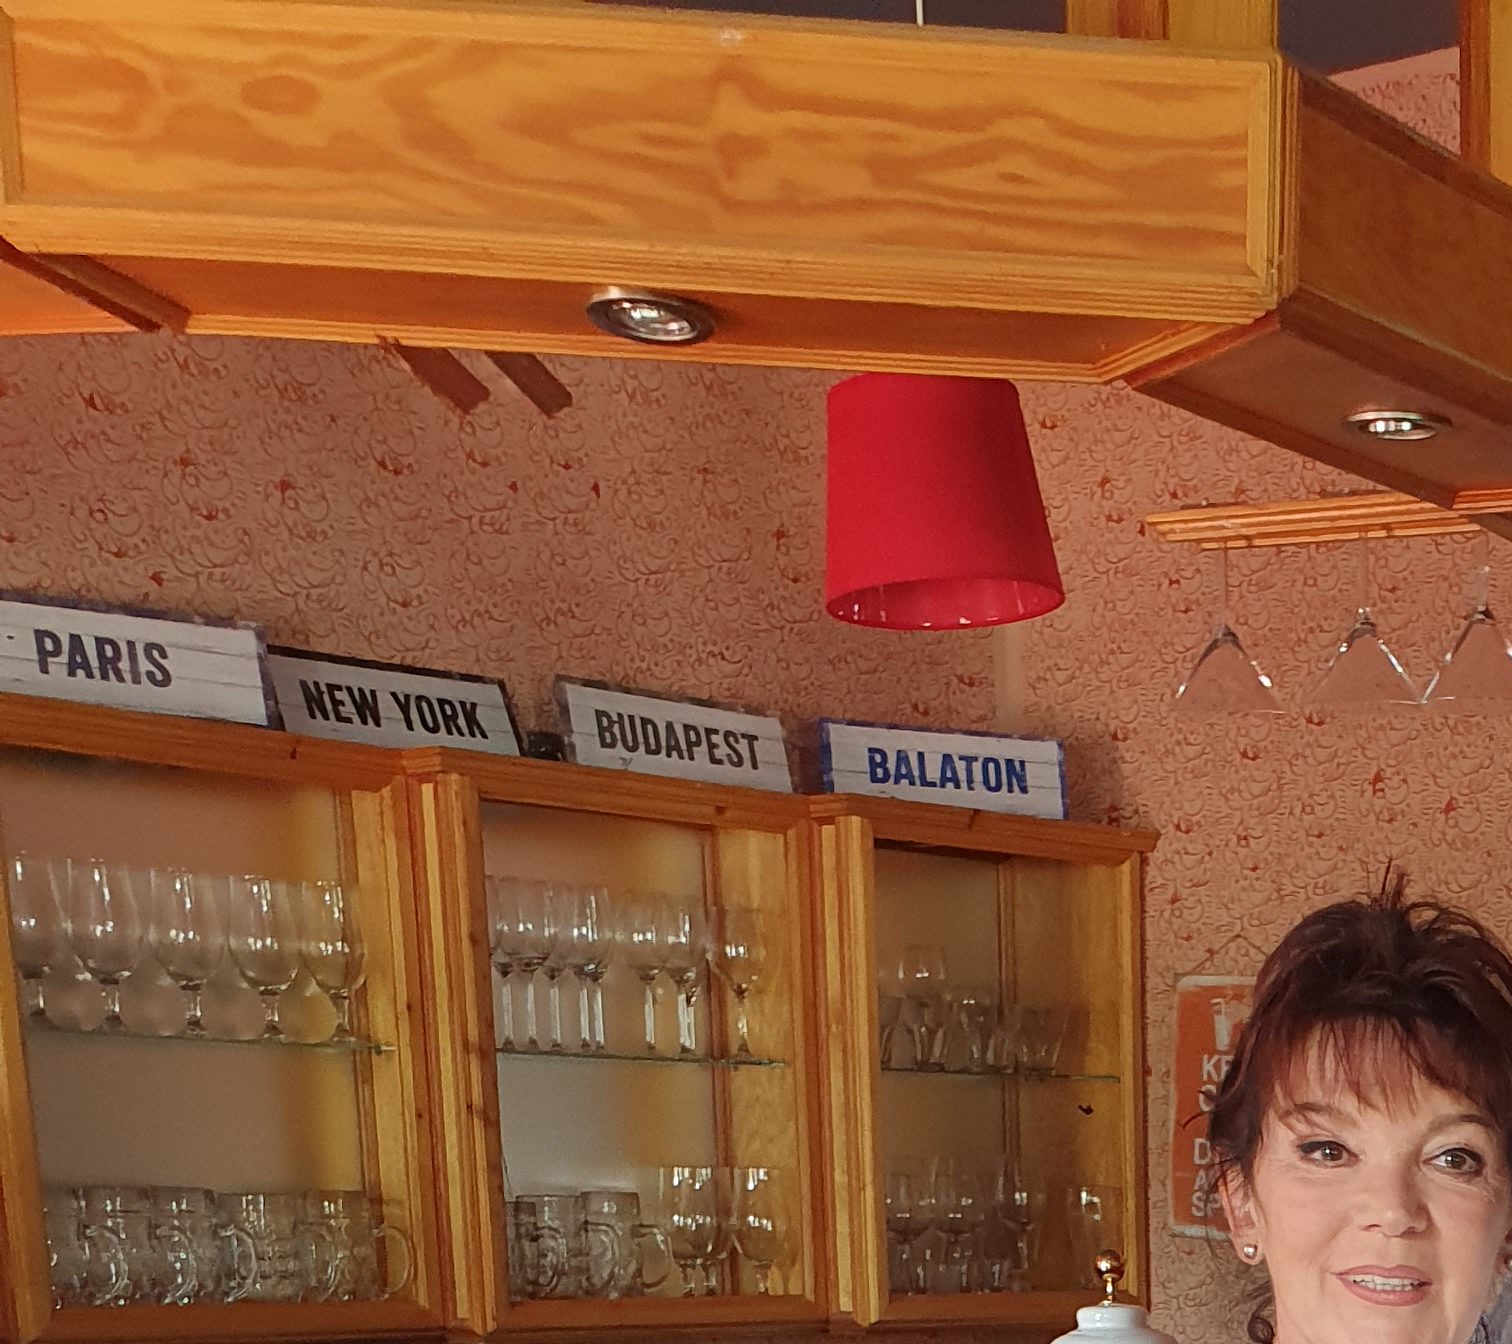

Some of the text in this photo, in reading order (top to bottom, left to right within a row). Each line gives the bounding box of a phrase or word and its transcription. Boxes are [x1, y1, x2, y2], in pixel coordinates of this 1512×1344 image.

[33, 628, 172, 688] PARIS
[299, 679, 489, 740] NEW YORK
[594, 708, 760, 770] BUDAPEST
[867, 747, 1029, 795] BALATON
